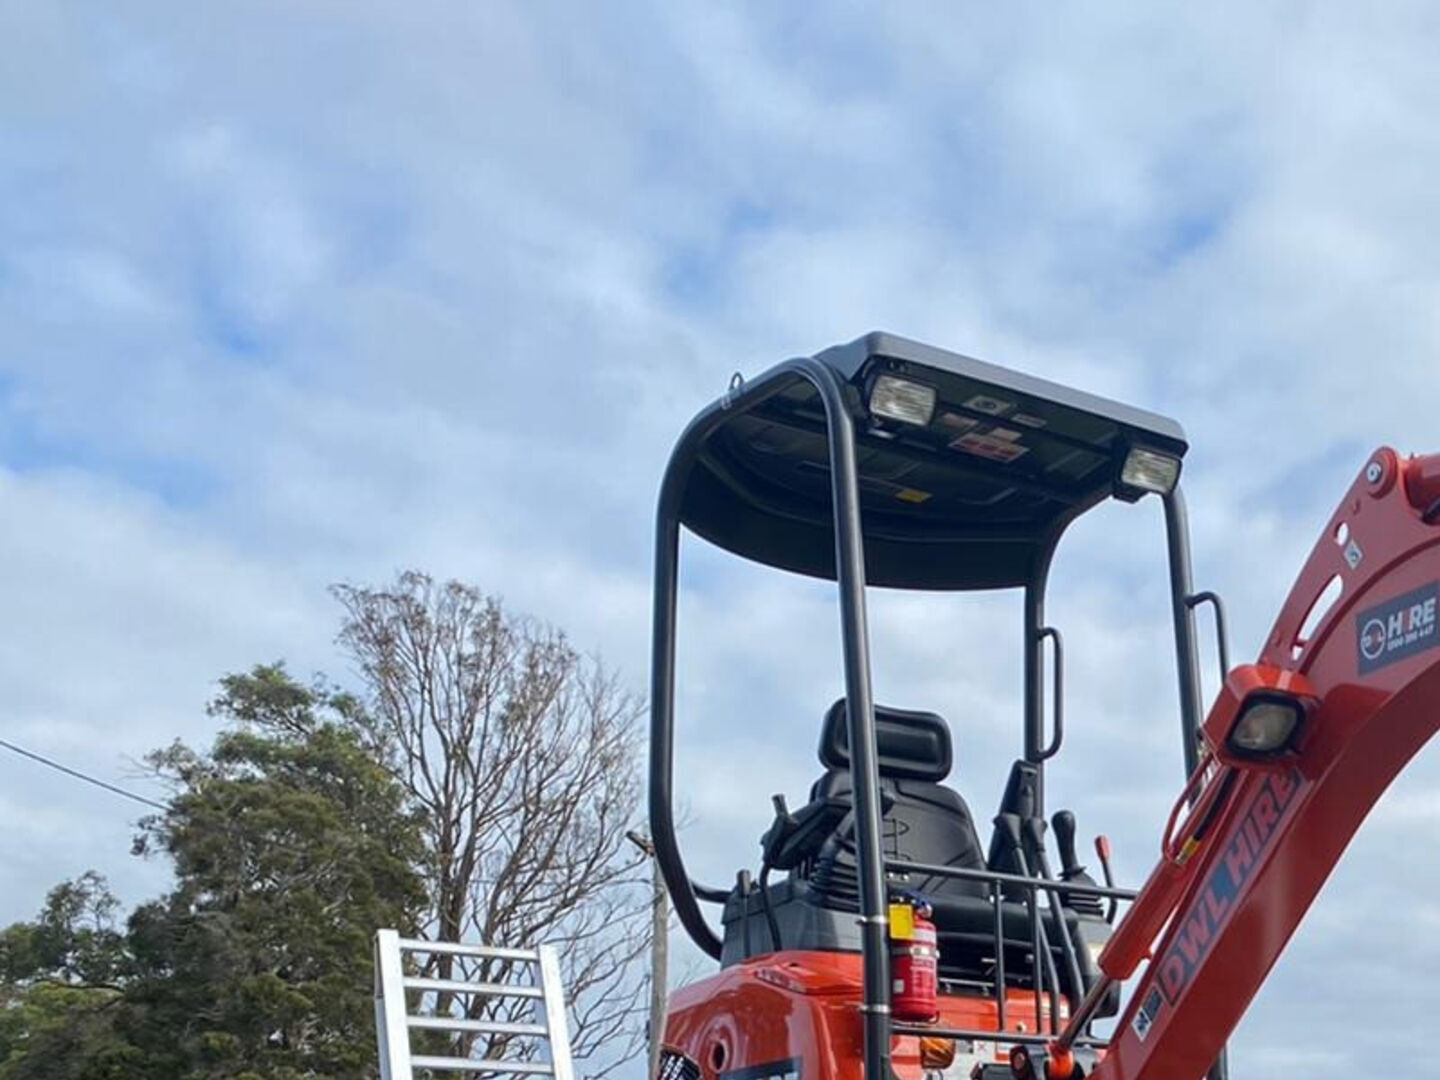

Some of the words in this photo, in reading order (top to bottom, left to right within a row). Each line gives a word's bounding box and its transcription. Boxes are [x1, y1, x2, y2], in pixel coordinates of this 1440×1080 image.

[1387, 597, 1436, 638] HIRE
[1161, 887, 1231, 997] DWL
[1228, 770, 1301, 884] HIRE
